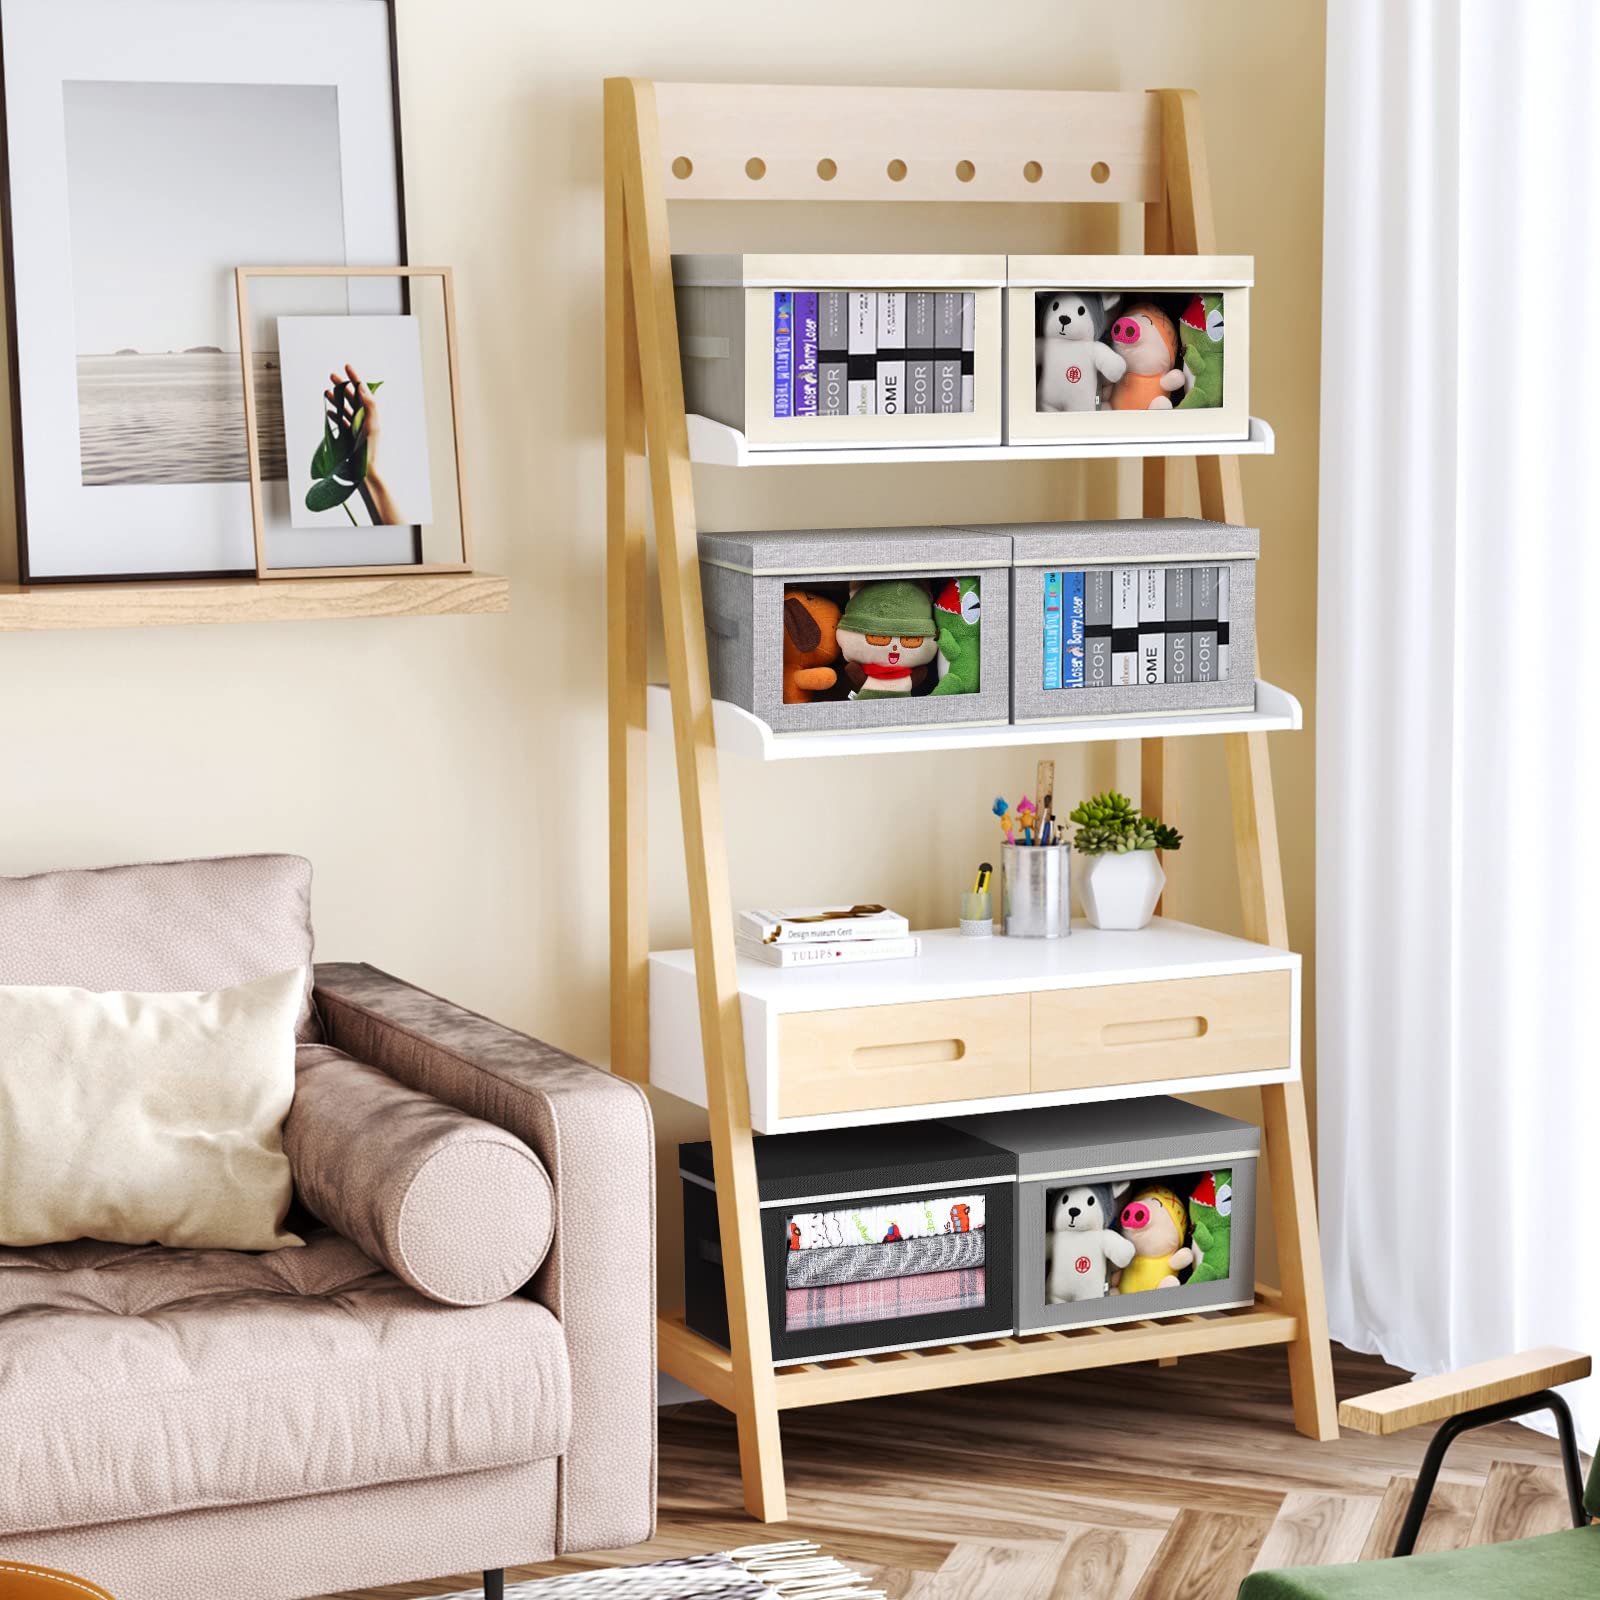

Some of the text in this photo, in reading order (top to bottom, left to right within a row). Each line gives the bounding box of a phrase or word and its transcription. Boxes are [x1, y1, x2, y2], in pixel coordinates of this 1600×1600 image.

[799, 344, 817, 370] Barry
[776, 336, 790, 415] QUANTUM THEORY
[1046, 614, 1058, 655] QUANTUM
[1066, 616, 1083, 644] Barry
[788, 929, 810, 939] Design
[811, 930, 836, 938] museum
[792, 950, 833, 961] TULIPS
